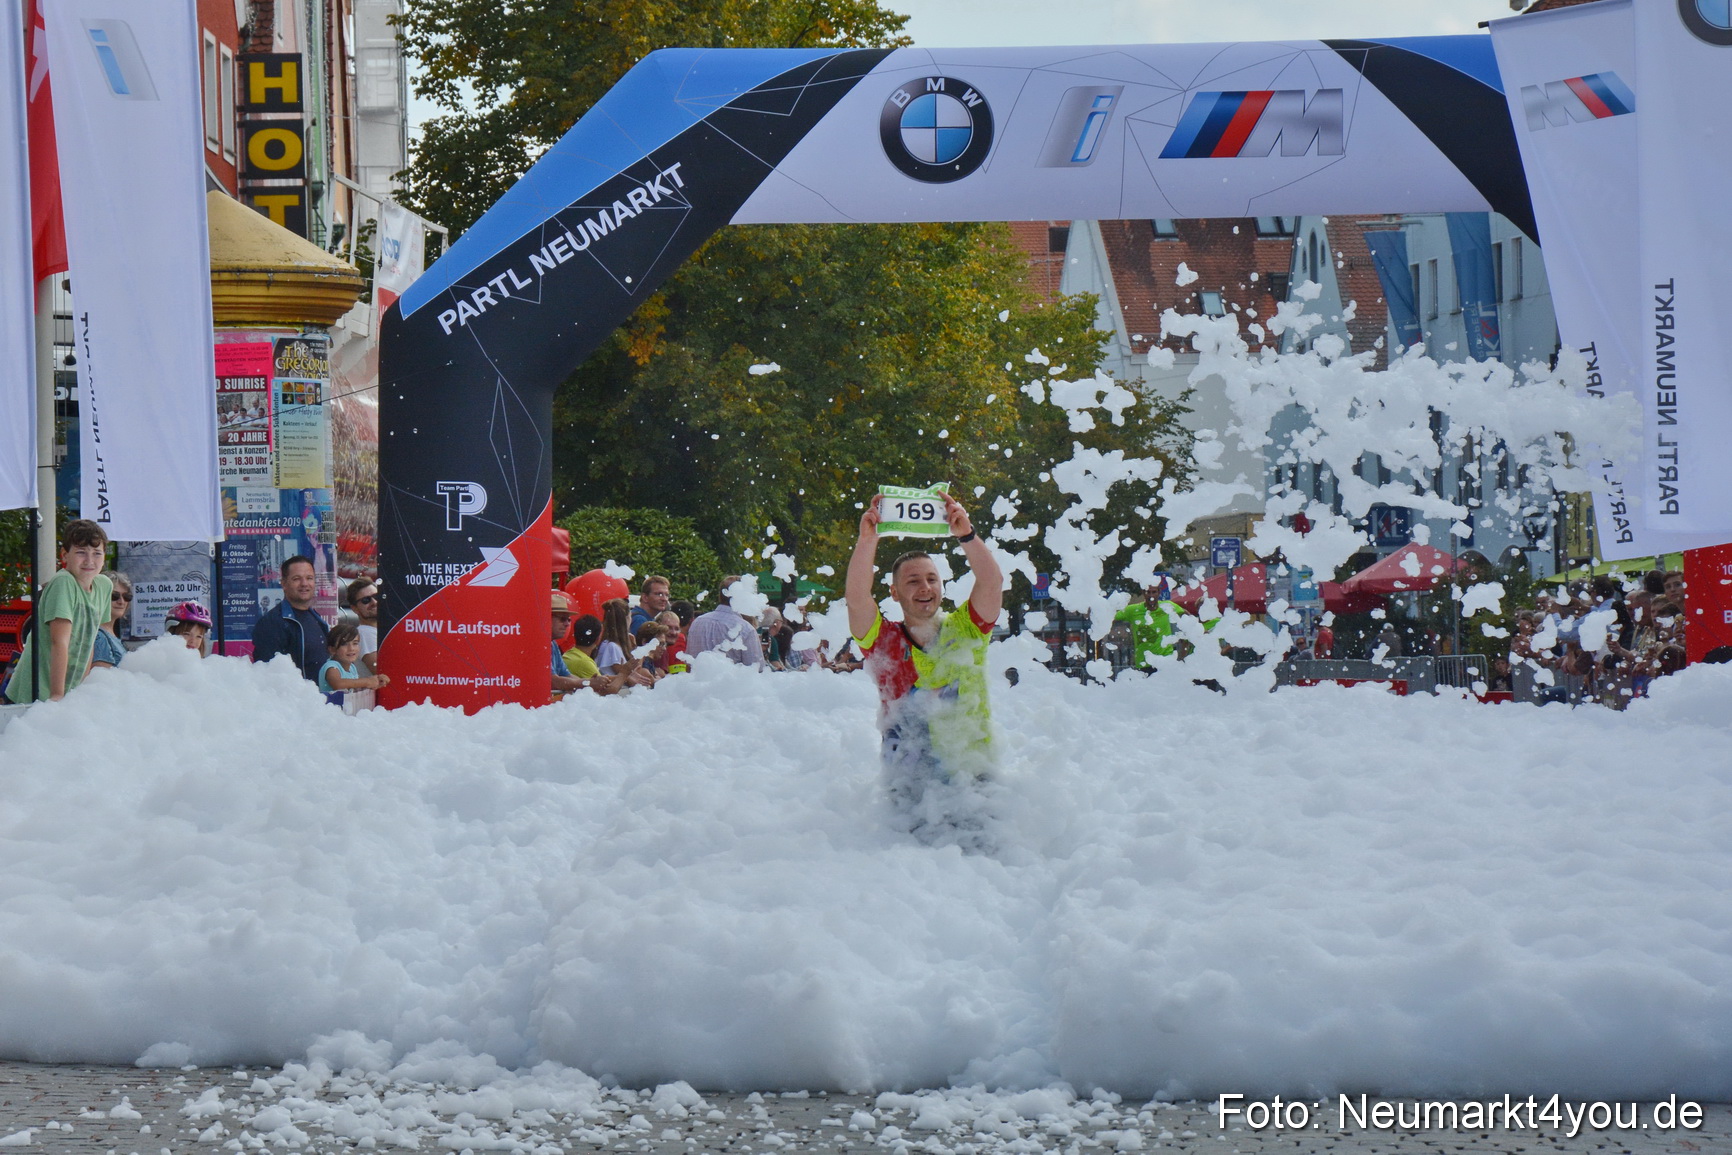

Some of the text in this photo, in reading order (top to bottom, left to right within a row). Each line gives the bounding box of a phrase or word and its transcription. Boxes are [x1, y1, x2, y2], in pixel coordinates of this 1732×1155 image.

[890, 77, 984, 110] BMW
[437, 161, 686, 336] PARTL NEUMARKT
[224, 377, 266, 390] SUNRISE
[228, 431, 267, 443] 20 JAHRE
[244, 446, 267, 454] Konzert
[234, 456, 254, 466] 18.30
[255, 456, 267, 465] Uhr
[239, 466, 268, 475] Neumarkt
[895, 502, 935, 520] 169
[282, 516, 301, 527] 2019
[421, 563, 474, 575] THE NEXT
[405, 575, 461, 586] 100 YEARS
[135, 583, 201, 593] Sa. 19. Okt. 20 Uhr
[405, 619, 521, 638] BMW Laufsport
[405, 673, 521, 688] www.bmw-partl.de
